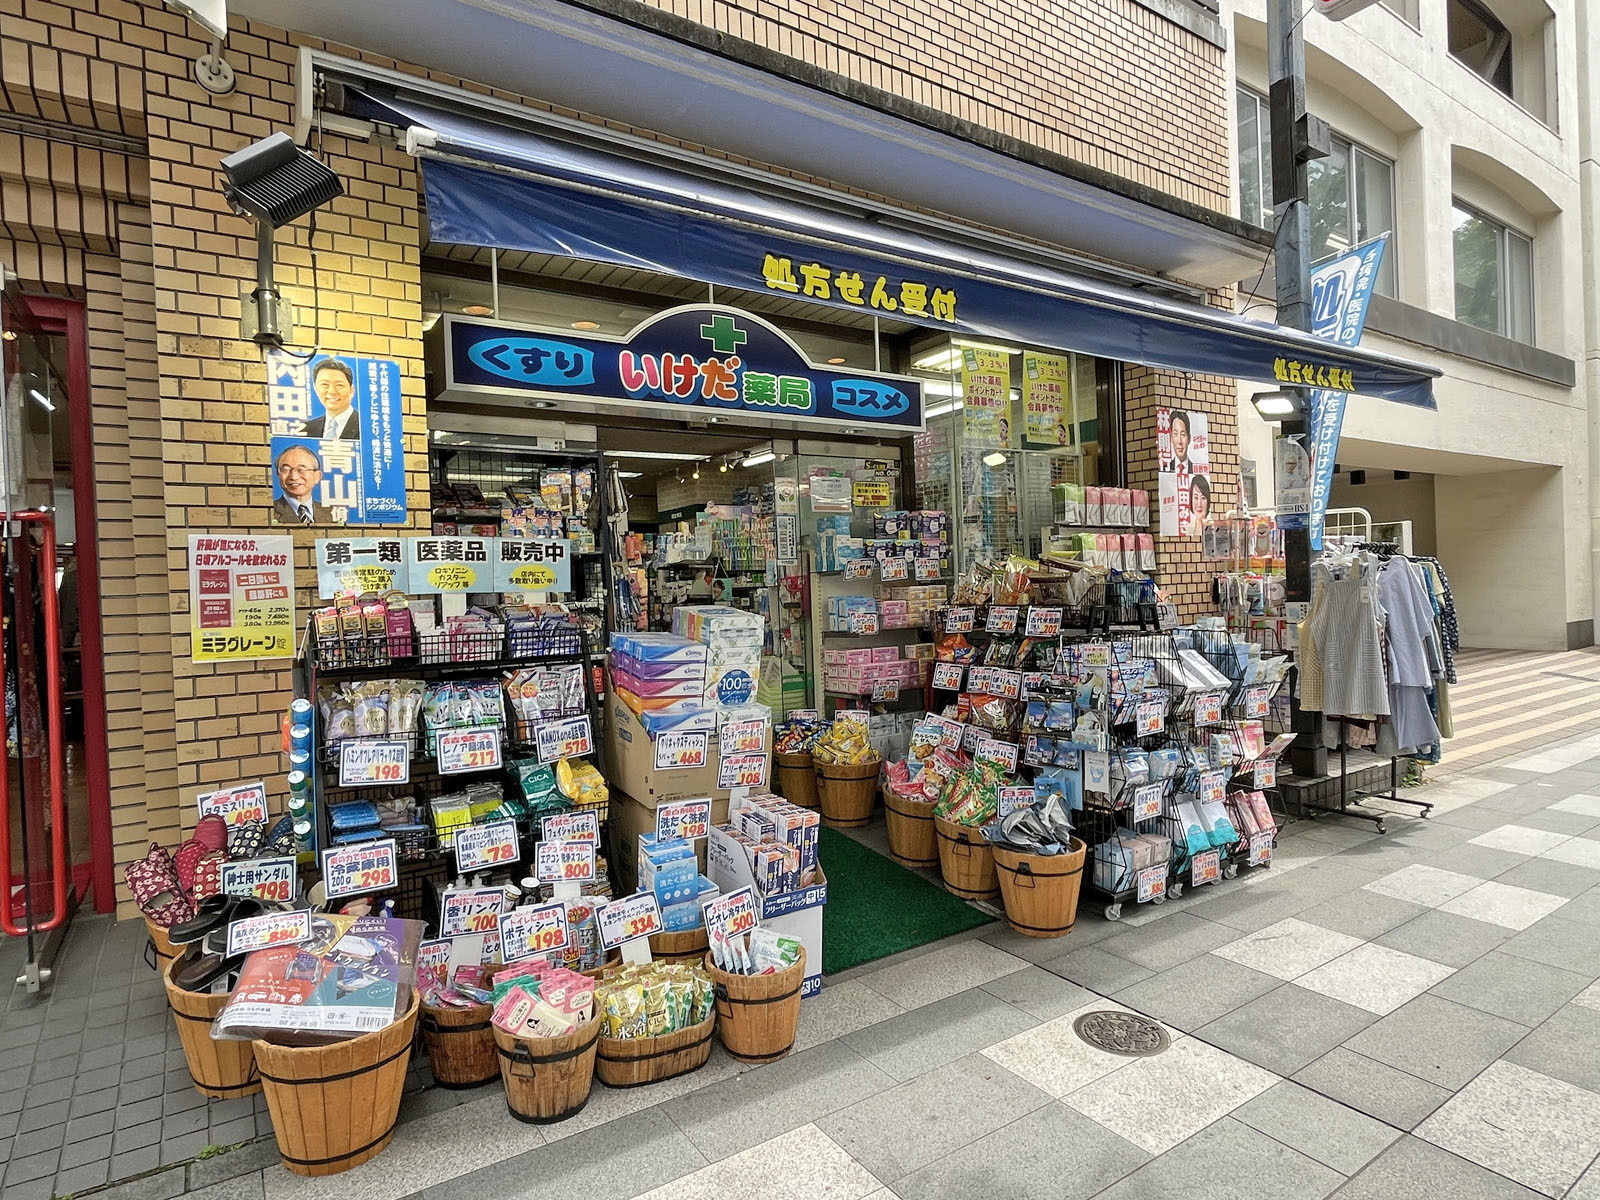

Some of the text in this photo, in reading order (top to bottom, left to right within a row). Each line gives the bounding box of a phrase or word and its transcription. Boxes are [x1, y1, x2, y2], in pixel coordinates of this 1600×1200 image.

[763, 254, 957, 323] 処方せん受付
[480, 343, 585, 376] くすり
[619, 350, 812, 410] いけだ薬局
[1274, 357, 1355, 391] 処方せん受付
[835, 386, 904, 411] コスメ
[270, 419, 308, 437] 直之
[318, 439, 358, 508] 青山
[195, 554, 287, 566] 日頃アルコールを飲まれる方
[325, 541, 401, 565] 第一類
[416, 541, 487, 563] 医薬品
[501, 541, 564, 563] 販売中
[520, 570, 546, 578] 店内にて
[202, 635, 287, 653] ミラグレーン錠
[565, 739, 589, 756] 578
[469, 750, 495, 767] 217
[679, 751, 703, 765] 468
[375, 764, 401, 781] 198
[527, 773, 549, 784] CICA
[740, 772, 761, 785] 108
[592, 791, 603, 799] VC
[204, 796, 263, 815] タタミスリッパ
[234, 807, 262, 826] 498
[660, 811, 709, 829] 洗たく洗剤
[682, 823, 706, 838] 198
[487, 843, 515, 863] 78
[330, 856, 391, 876] 冷蔵庫用
[564, 863, 591, 878] 800
[227, 866, 290, 887] 紳士用サンダル
[360, 868, 391, 888] 298
[254, 880, 290, 900] 798
[815, 887, 826, 899] 15
[709, 900, 753, 926] ビオレ冷タオル
[732, 911, 754, 934] 500
[472, 914, 498, 932] 700
[505, 916, 565, 940] ボディシート
[630, 915, 655, 936] 334
[267, 928, 300, 944] 880
[534, 928, 565, 952] 198
[809, 978, 822, 990] 10
[648, 1013, 668, 1026] CICA
